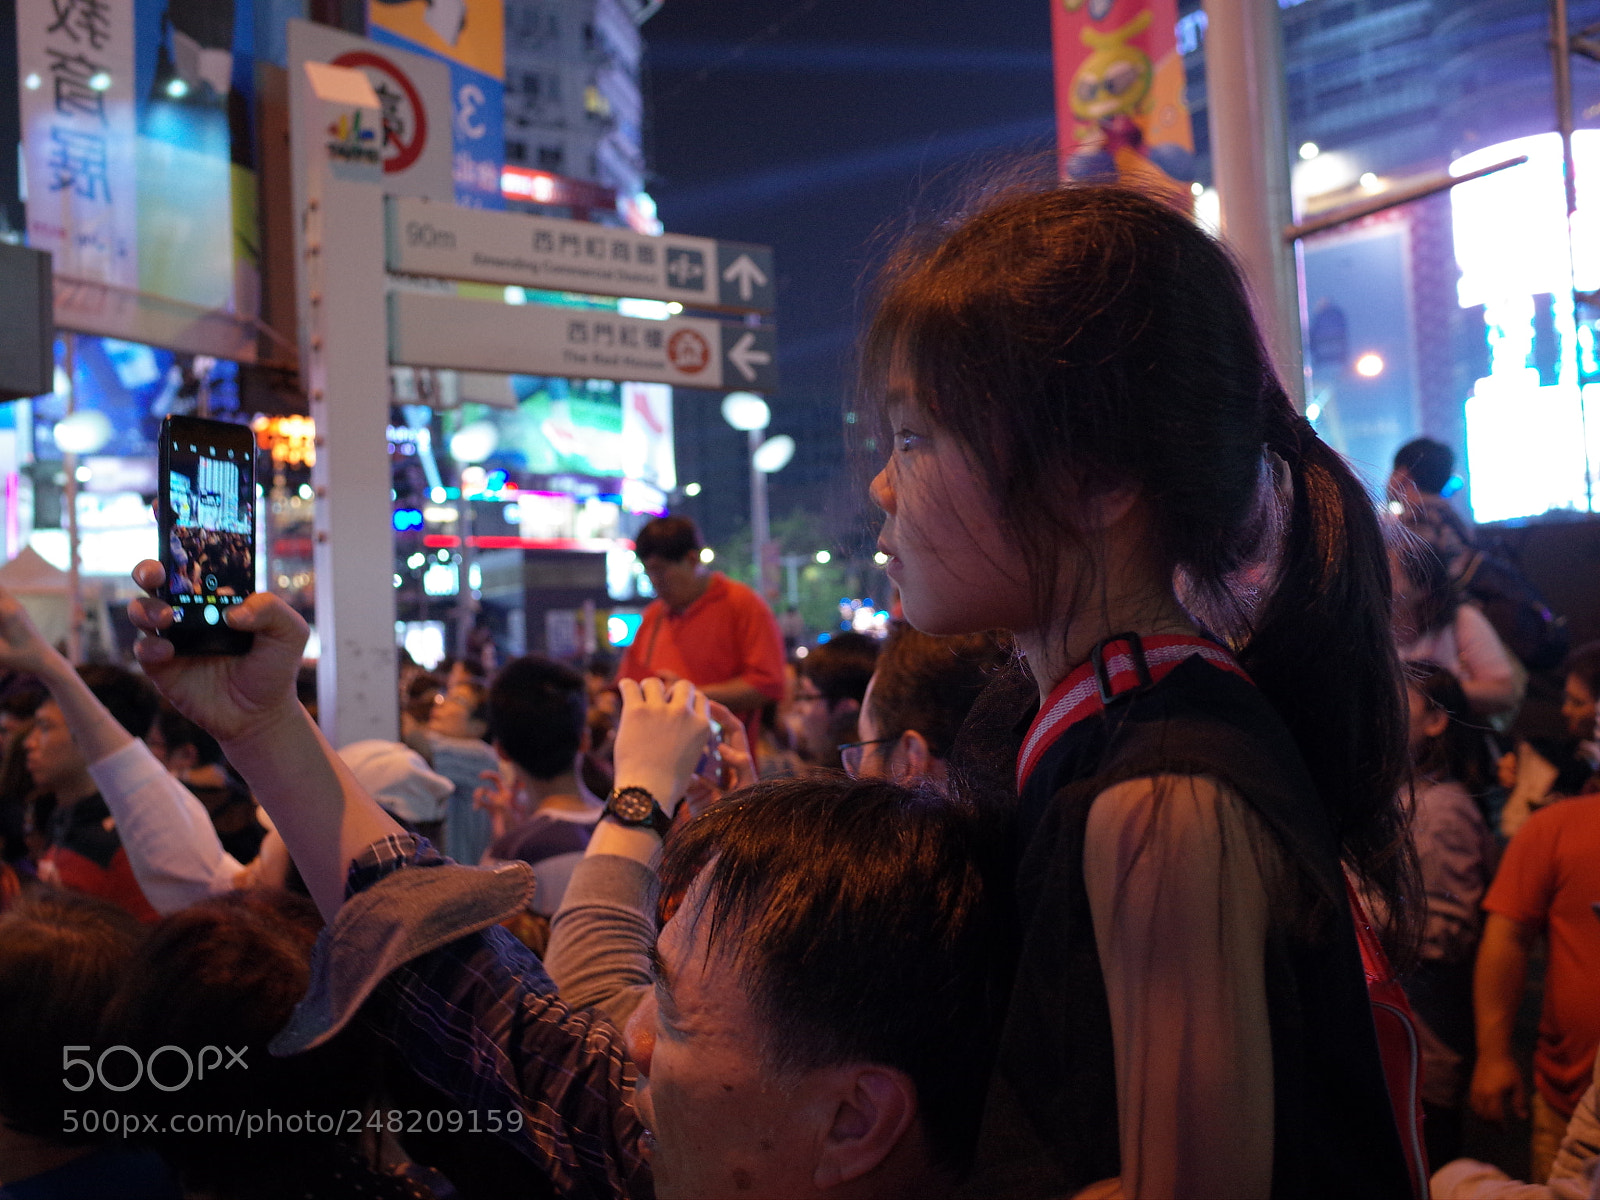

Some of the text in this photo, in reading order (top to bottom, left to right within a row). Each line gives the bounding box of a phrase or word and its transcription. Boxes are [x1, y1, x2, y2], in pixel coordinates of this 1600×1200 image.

[406, 221, 457, 248] 90m
[568, 321, 663, 349] 西門紅樓
